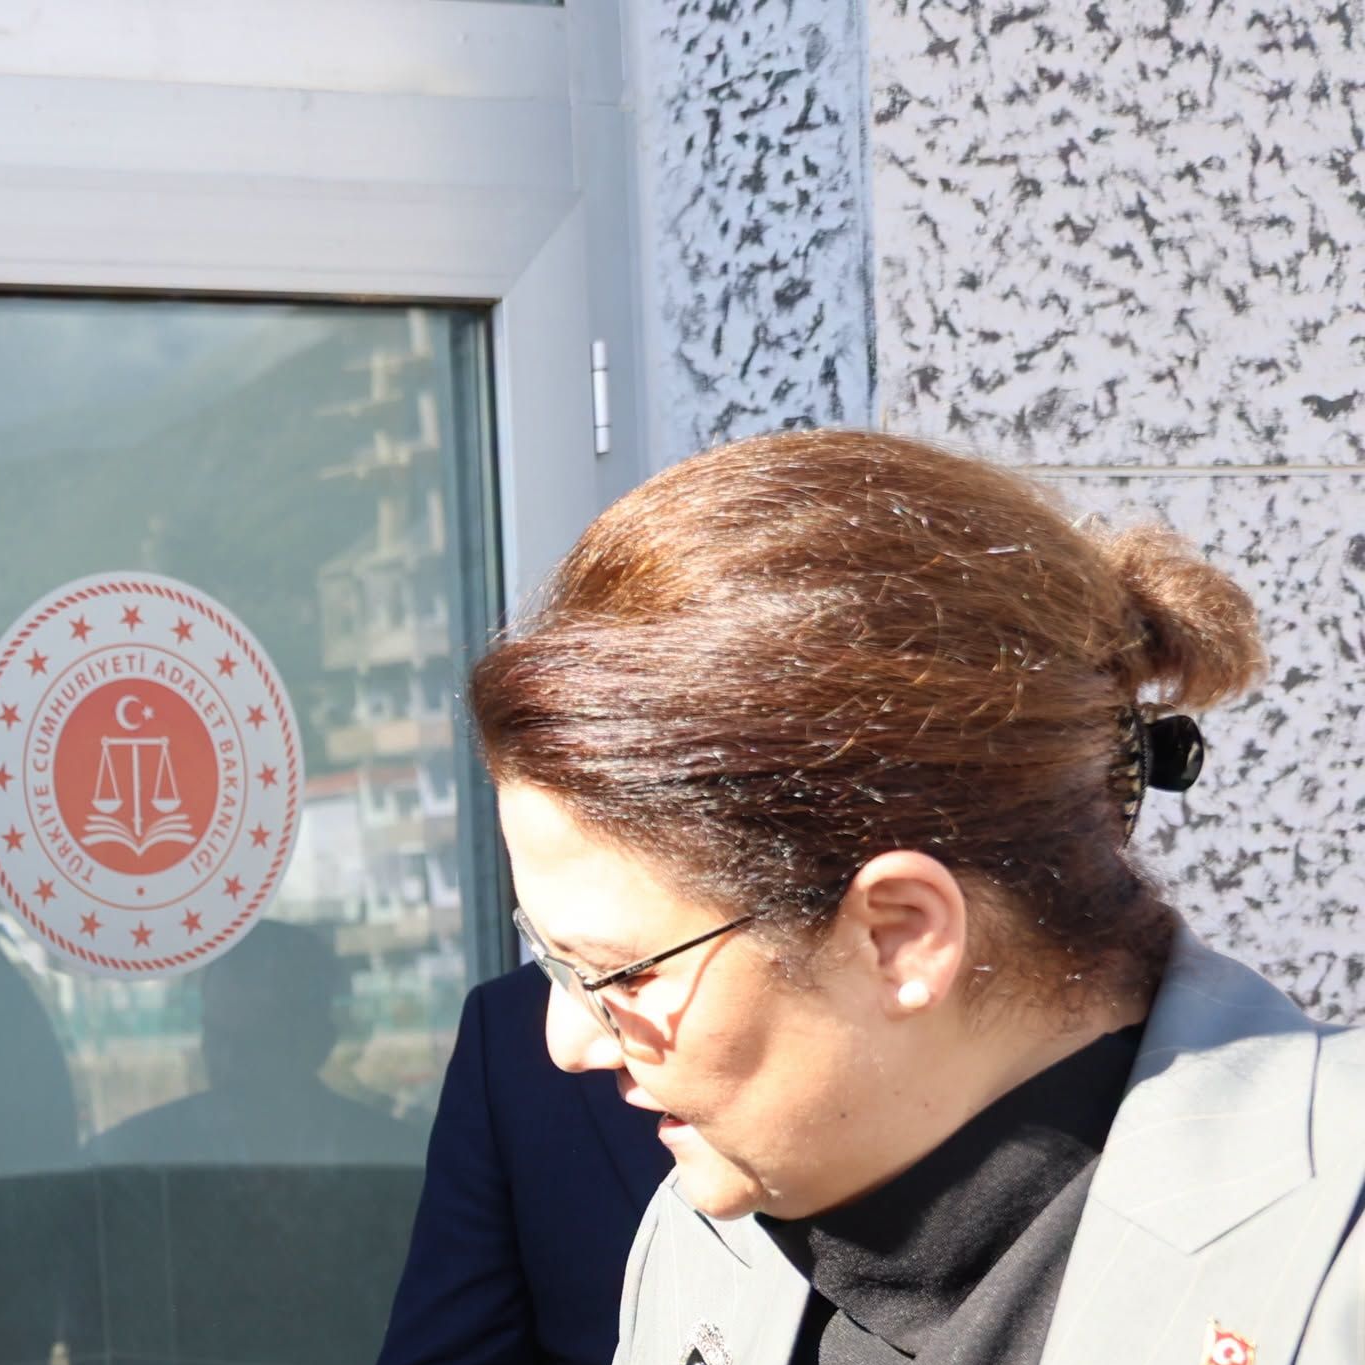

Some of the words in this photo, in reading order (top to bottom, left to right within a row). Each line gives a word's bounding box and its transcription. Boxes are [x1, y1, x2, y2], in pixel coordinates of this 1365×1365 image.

[33, 652, 146, 772] CUMHURİYETİ
[154, 661, 226, 730] ADALET
[33, 785, 95, 883] TÜRKİYE
[190, 740, 238, 875] BAKANLIĞI
